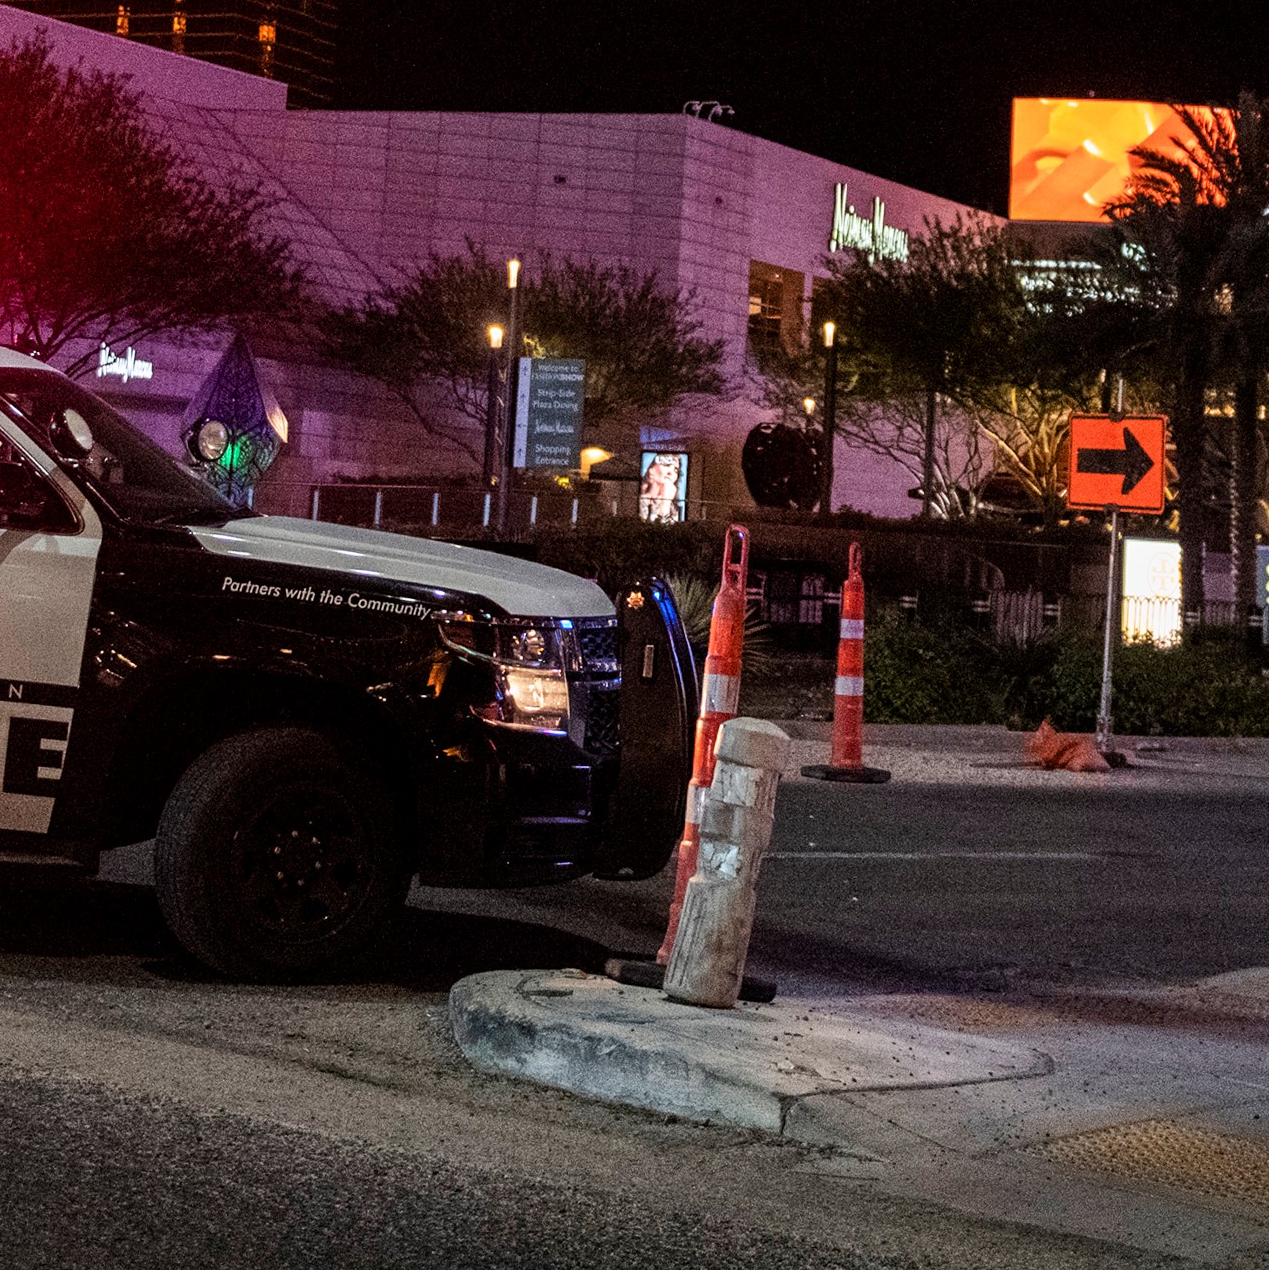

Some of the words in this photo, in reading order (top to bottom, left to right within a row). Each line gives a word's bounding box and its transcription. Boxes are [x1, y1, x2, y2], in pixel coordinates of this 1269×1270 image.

[538, 364, 569, 372] Welcome
[571, 364, 580, 372] to
[537, 388, 576, 399] Strip-Side
[532, 400, 552, 409] Plaza
[553, 400, 579, 412] Dining
[535, 444, 572, 456] Shopping
[535, 456, 569, 466] Entrance
[222, 576, 281, 597] Partners
[285, 587, 316, 602] with
[319, 590, 343, 606] the
[347, 593, 431, 621] Community
